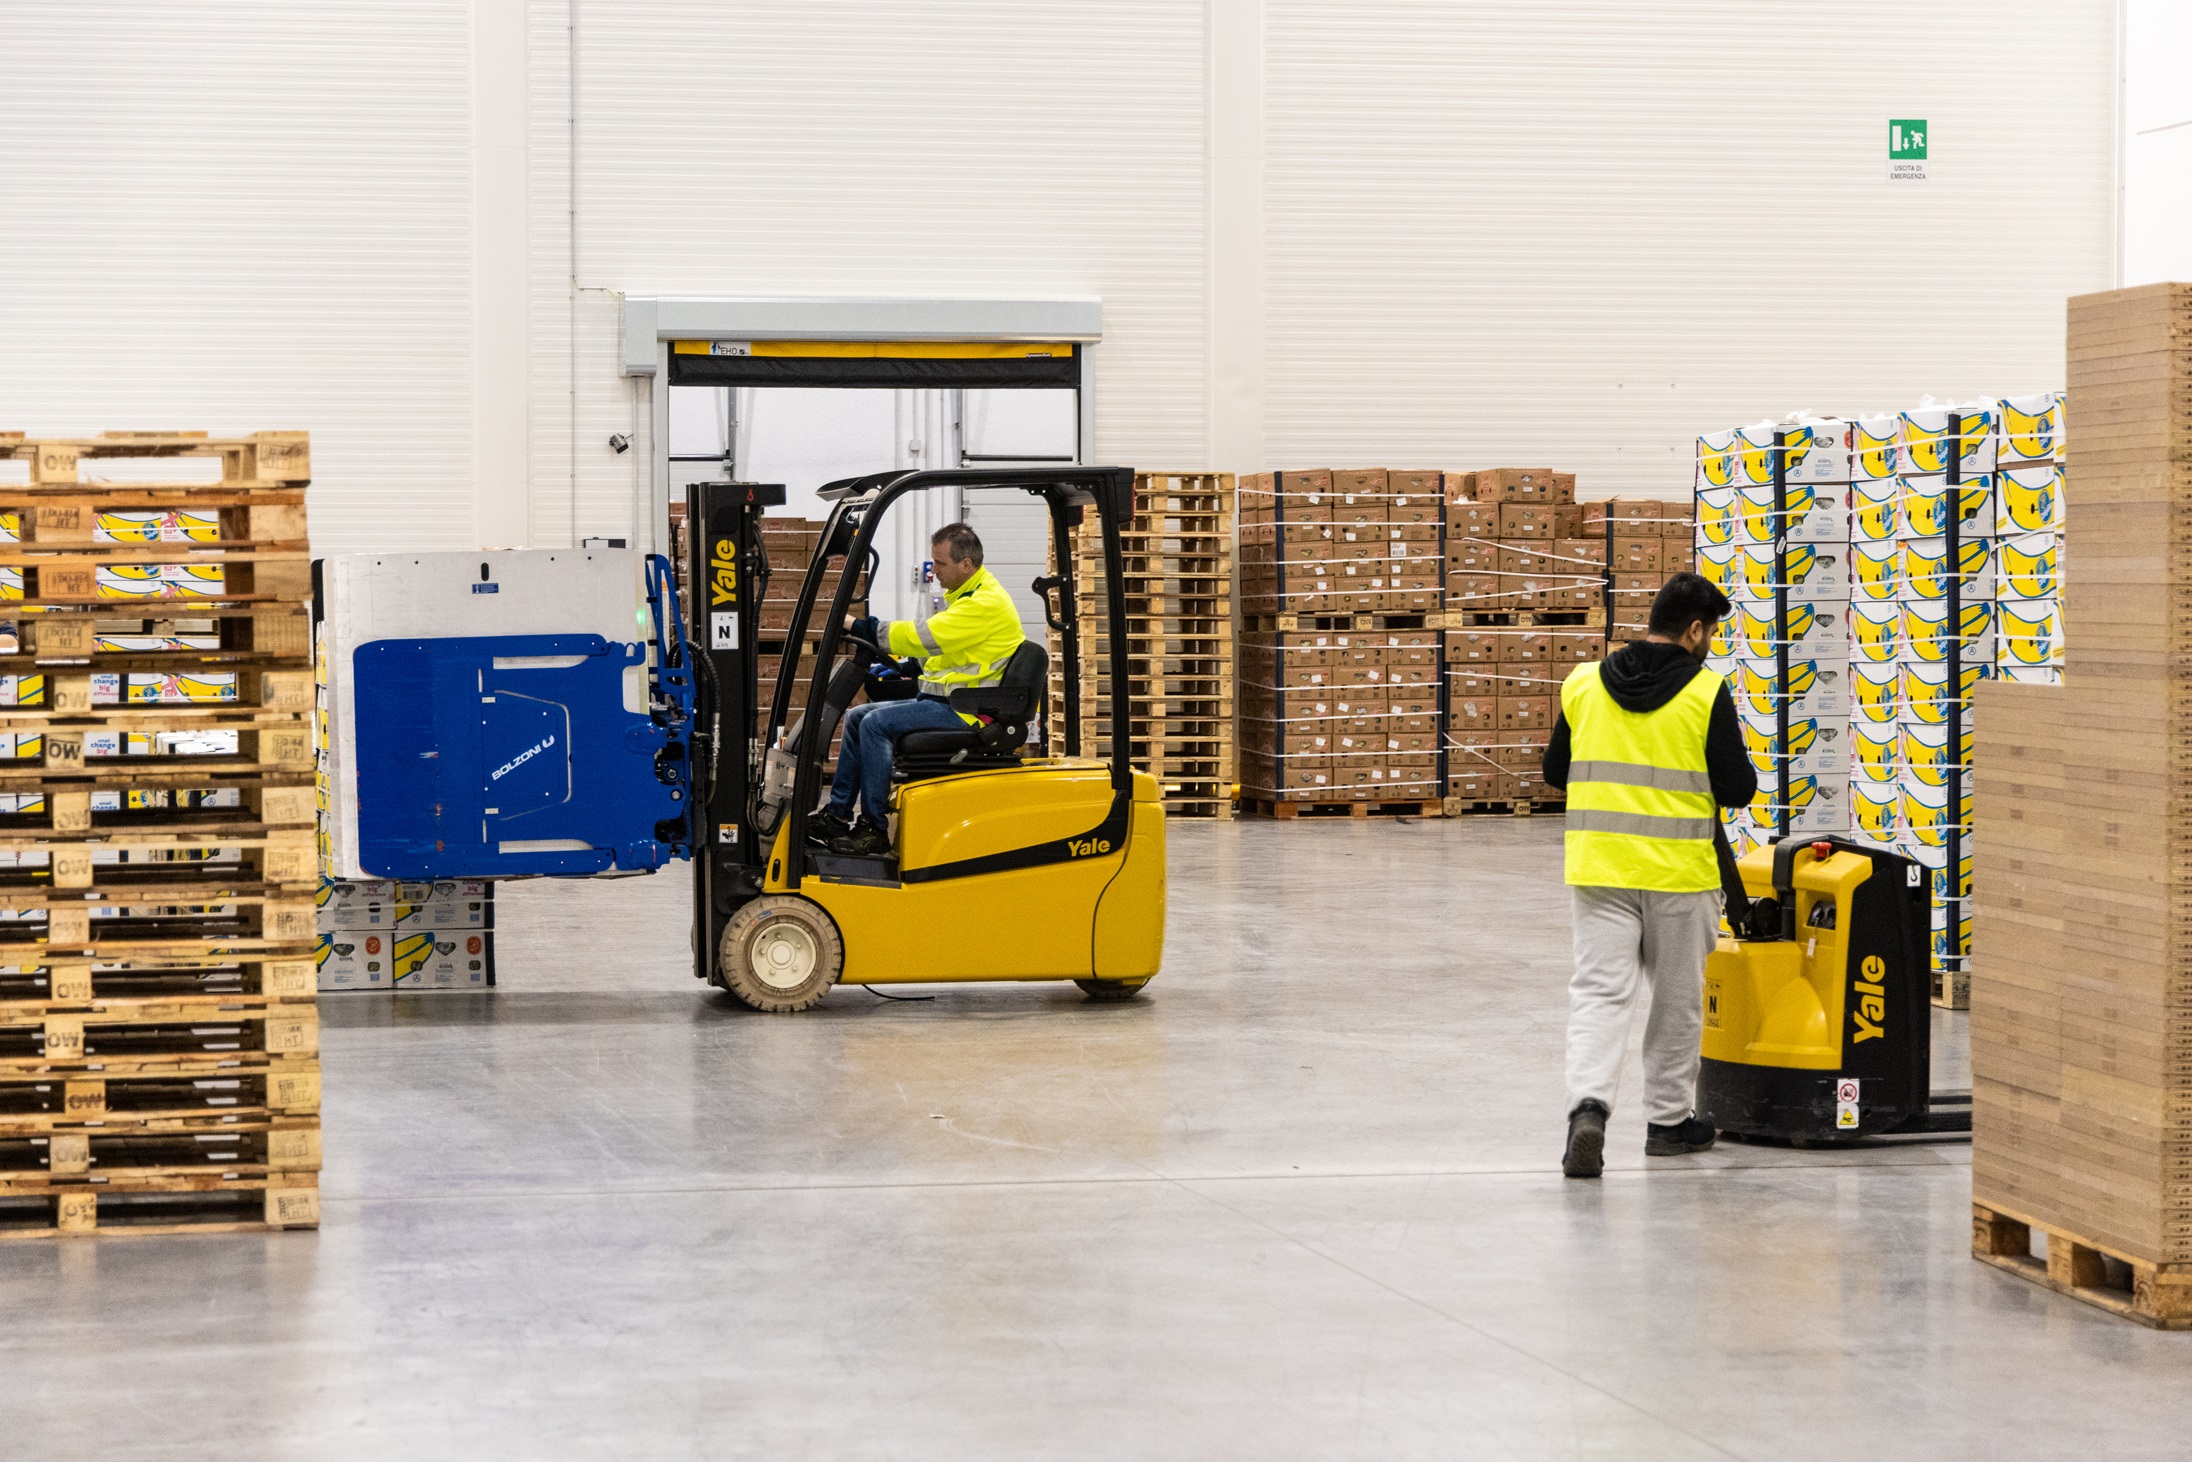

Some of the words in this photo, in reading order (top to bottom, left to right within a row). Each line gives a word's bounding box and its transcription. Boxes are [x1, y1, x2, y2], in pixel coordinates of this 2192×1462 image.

[711, 540, 736, 606] Yale
[719, 626, 730, 639] N
[48, 742, 81, 761] OW
[491, 744, 542, 781] BOLZONI
[1067, 838, 1111, 857] Yale
[1709, 995, 1717, 1014] N
[1853, 955, 1886, 1044] Yale
[47, 1032, 80, 1048] OW
